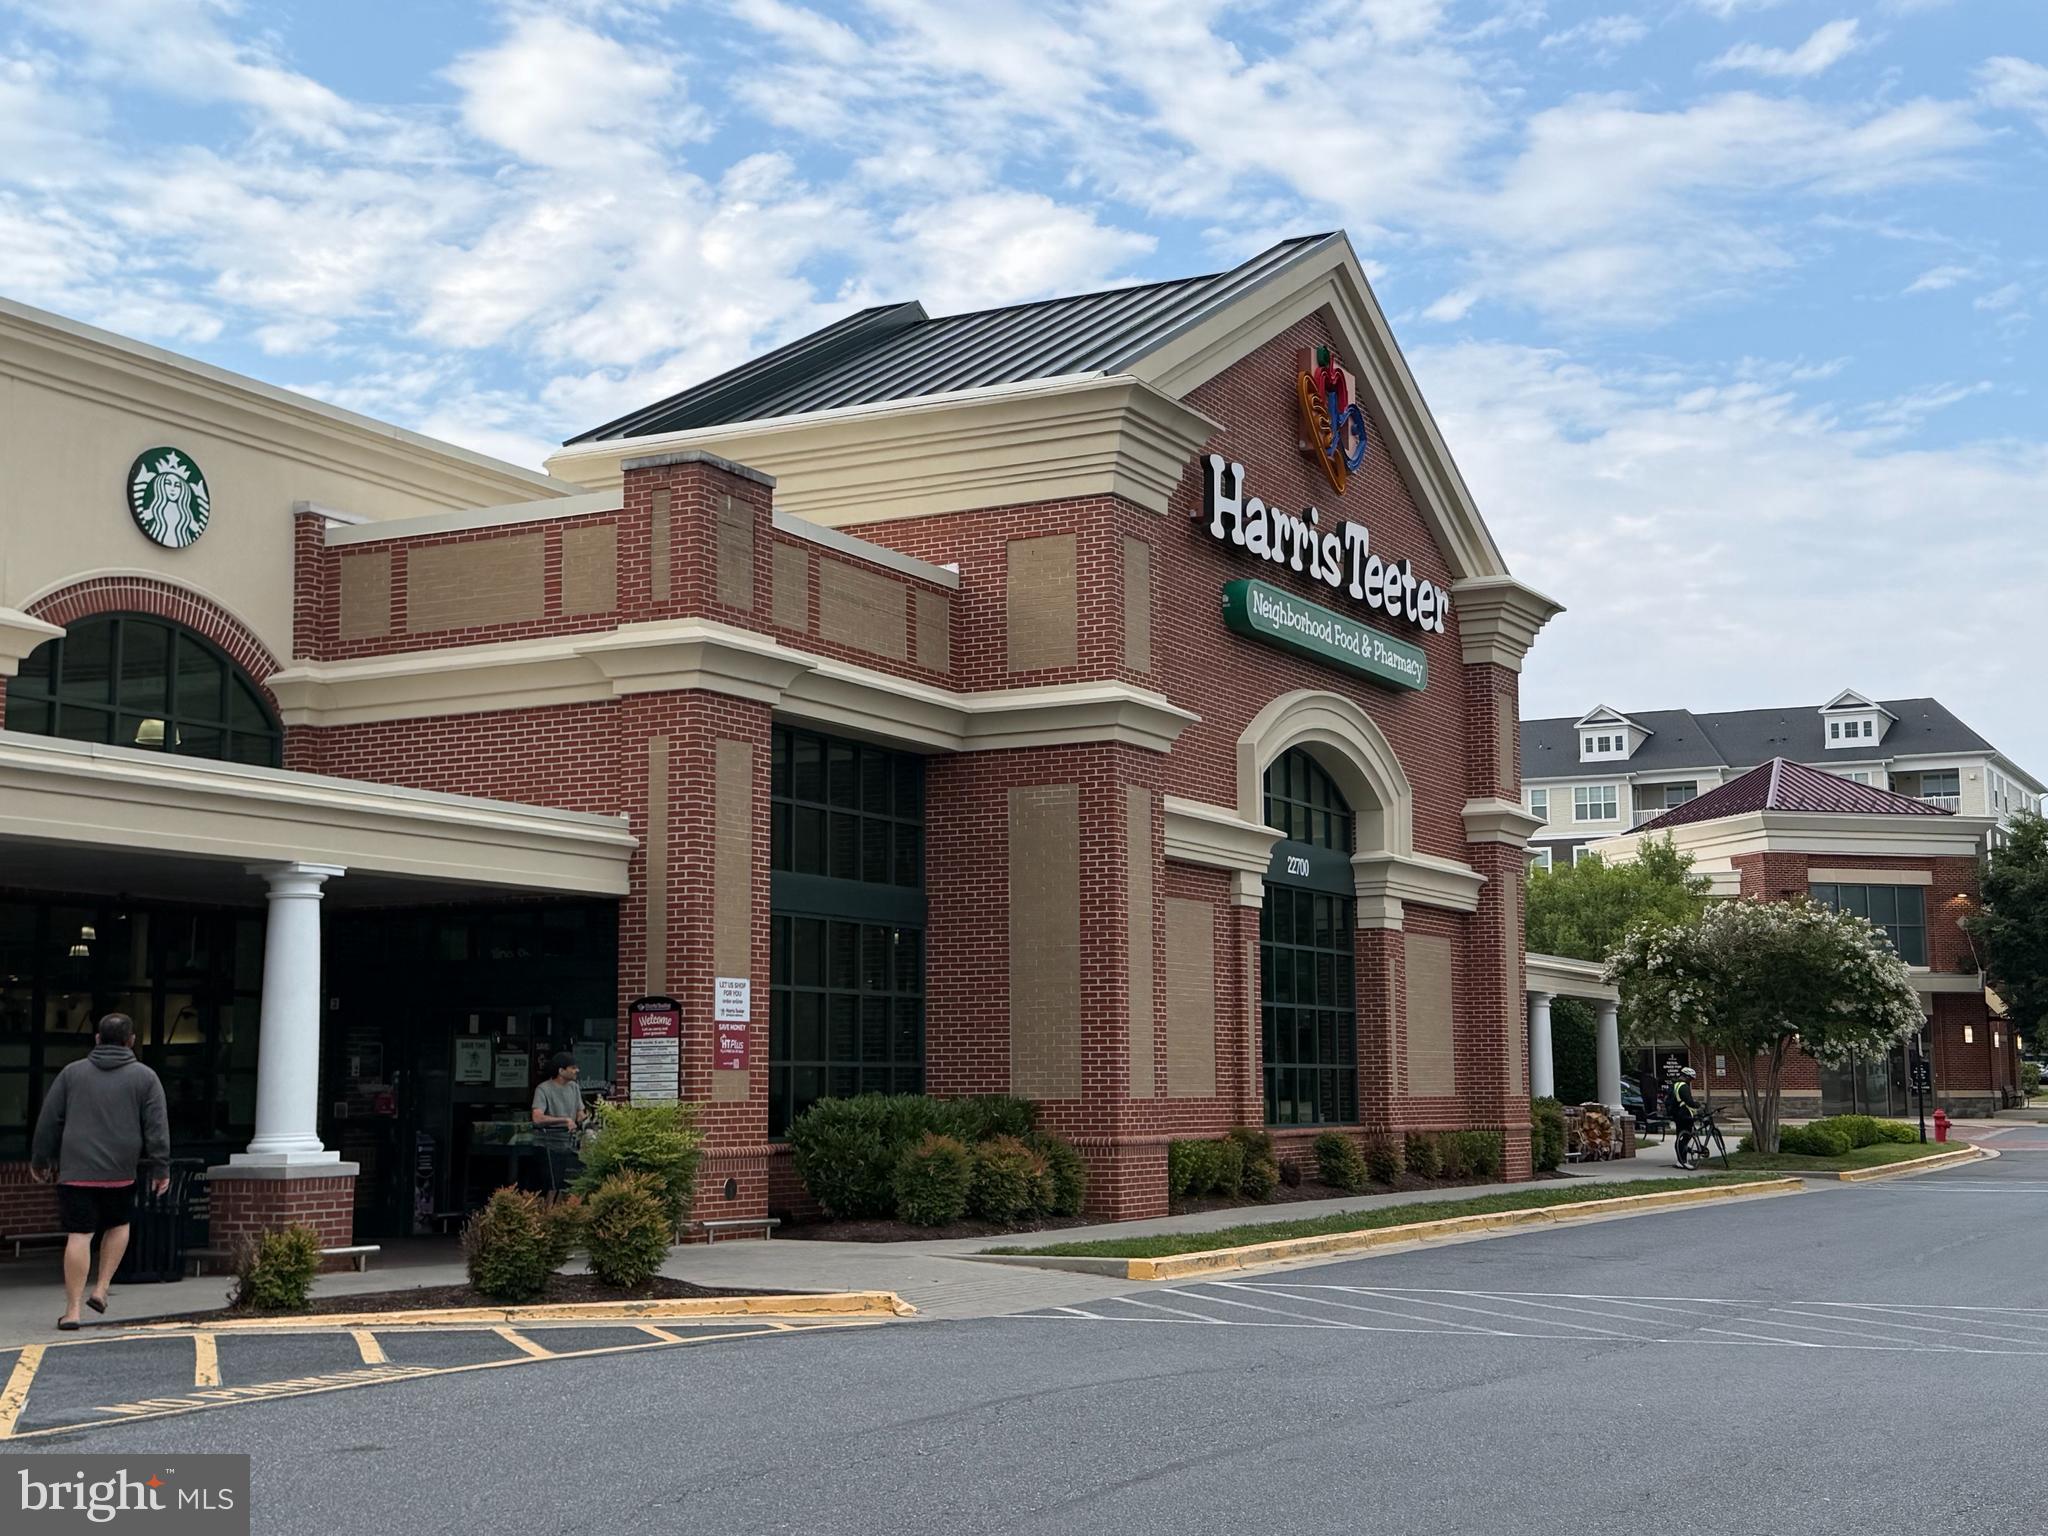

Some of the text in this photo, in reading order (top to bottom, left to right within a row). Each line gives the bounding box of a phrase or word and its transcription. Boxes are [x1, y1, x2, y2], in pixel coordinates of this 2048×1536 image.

[1253, 590, 1424, 684] Neighborhood Food & Pharmacy
[1287, 855, 1310, 877] 22700
[723, 989, 742, 998] FOR YOU
[638, 1013, 672, 1027] Welcome
[718, 1023, 730, 1031] SAVE
